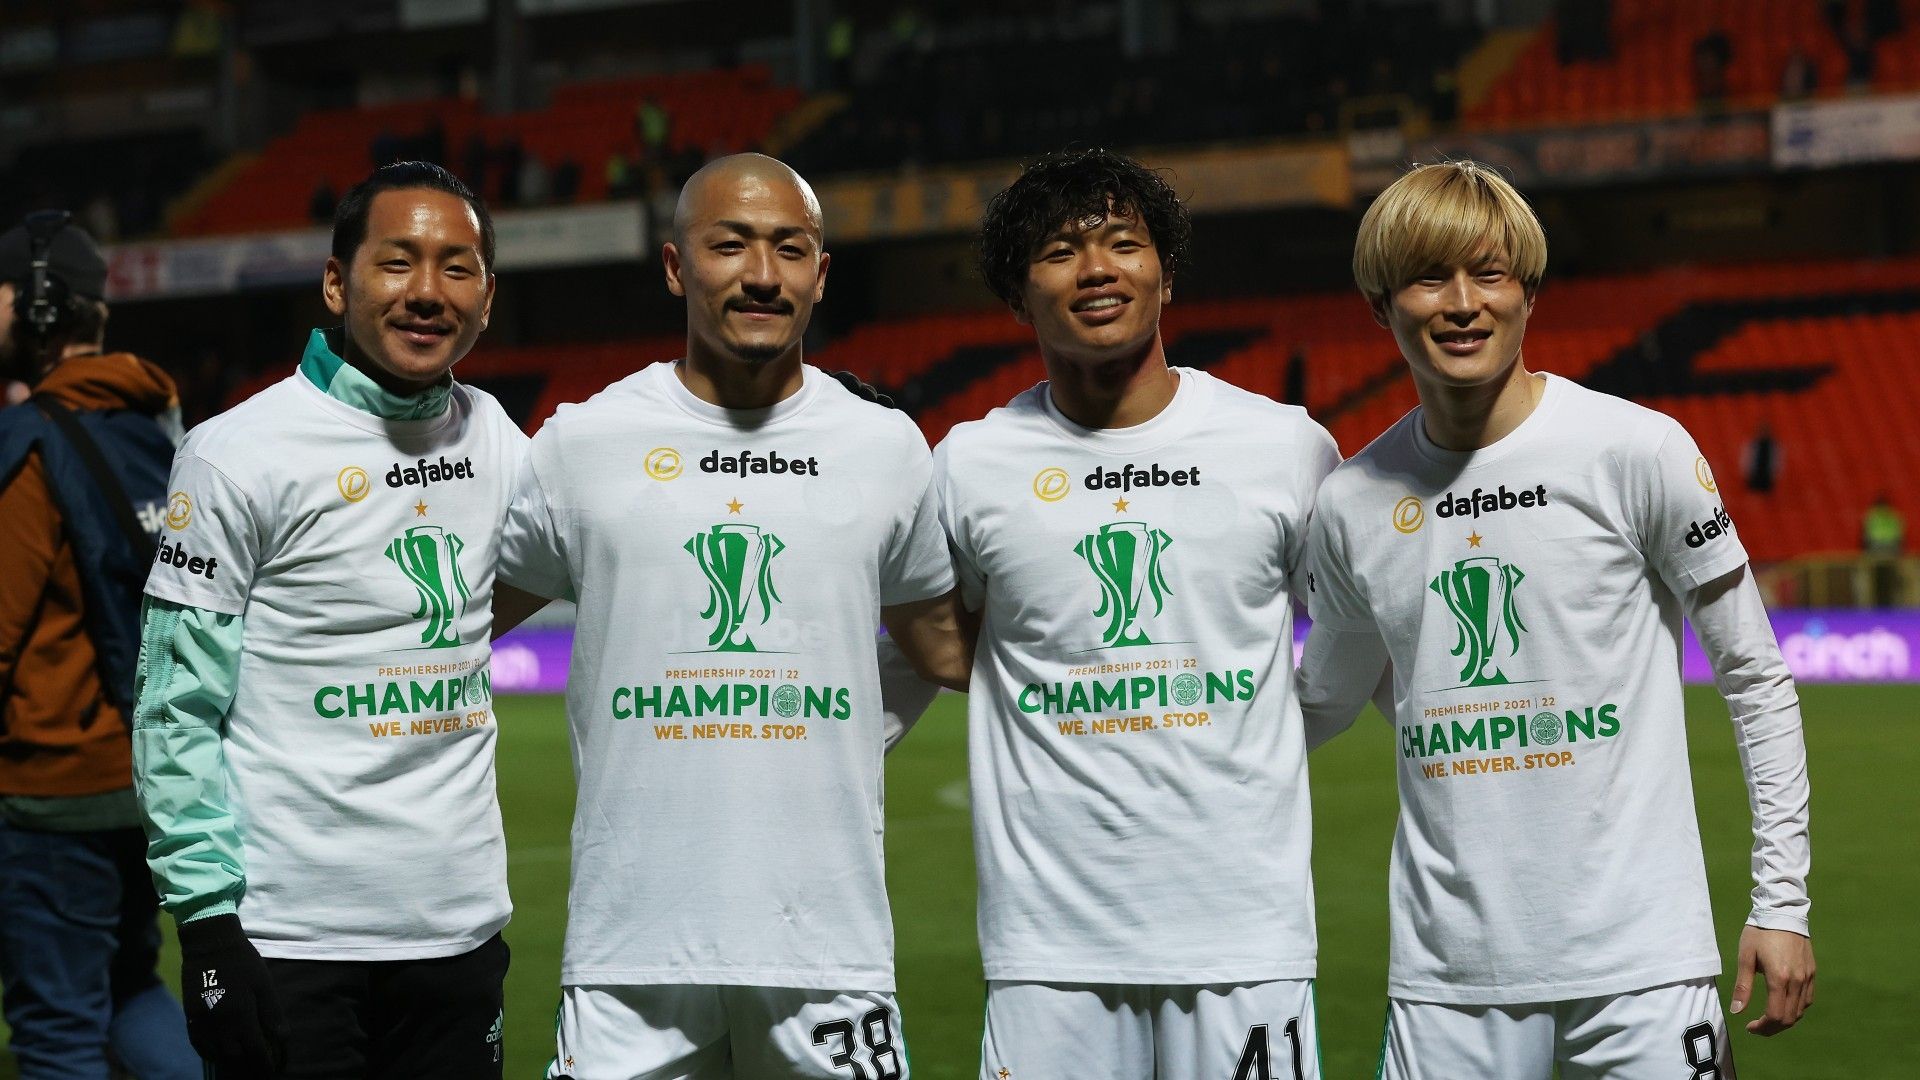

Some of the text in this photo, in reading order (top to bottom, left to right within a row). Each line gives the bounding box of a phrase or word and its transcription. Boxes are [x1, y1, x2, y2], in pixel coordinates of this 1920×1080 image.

[385, 456, 475, 488] dafabet
[699, 449, 819, 479] dafabet
[1084, 463, 1201, 492] dafabet
[1435, 484, 1548, 519] dafabet
[378, 663, 457, 677] PREMIERSHIP
[665, 668, 746, 679] PREMIERSHIP
[749, 669, 776, 679] 2021
[786, 670, 799, 679] 22
[1068, 662, 1142, 676] PREMIERSHIP
[1146, 660, 1172, 670] 2021
[1183, 658, 1197, 668] 22
[612, 684, 851, 720] CHAMPIONS
[1017, 669, 1255, 715] CHAMPIONS
[1424, 701, 1500, 718] PREMIERSHIP
[1504, 700, 1531, 711] 2021
[1541, 697, 1556, 707] 22
[369, 721, 407, 738] WE.
[410, 716, 463, 736] NEVER.
[654, 723, 807, 740] WE. NEVER. STOP.
[1057, 711, 1211, 736] WE. NEVER. STOP.
[1401, 703, 1621, 758] CHAMPIONS
[1421, 751, 1576, 780] WE. NEVER. STOP.
[811, 1007, 901, 1080] 38
[1230, 1016, 1306, 1080] 41
[1681, 1020, 1722, 1080] 8
